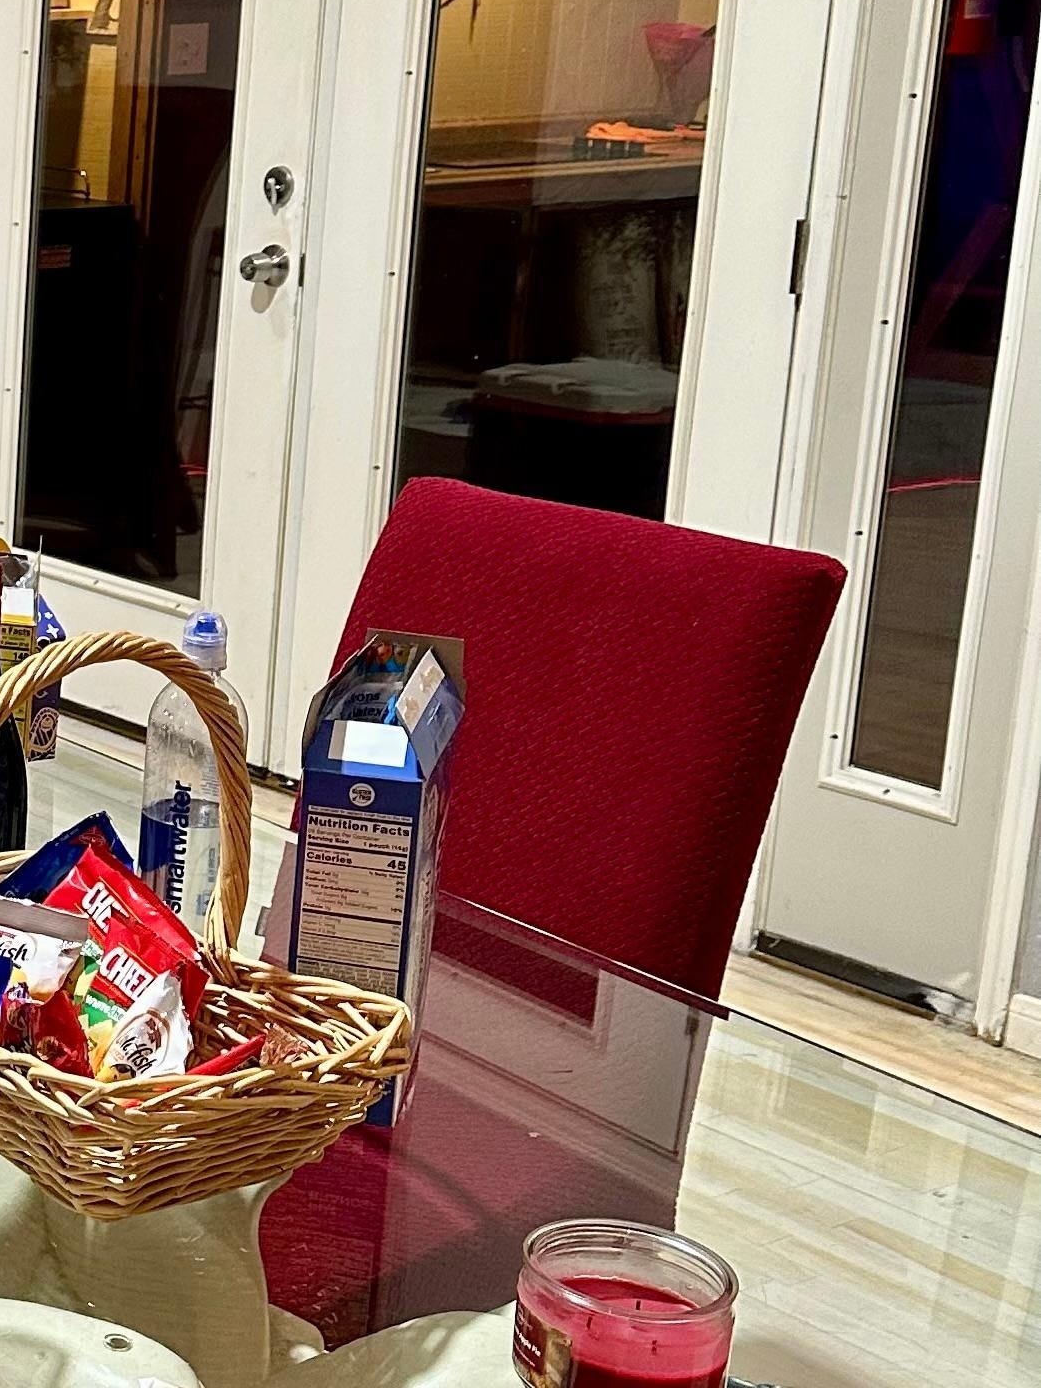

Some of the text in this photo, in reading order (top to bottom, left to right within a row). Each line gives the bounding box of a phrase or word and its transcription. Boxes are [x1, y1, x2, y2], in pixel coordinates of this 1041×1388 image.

[308, 815, 410, 837] Nutrition Facts
[165, 779, 192, 915] smartwater
[306, 851, 407, 871] Calories 45
